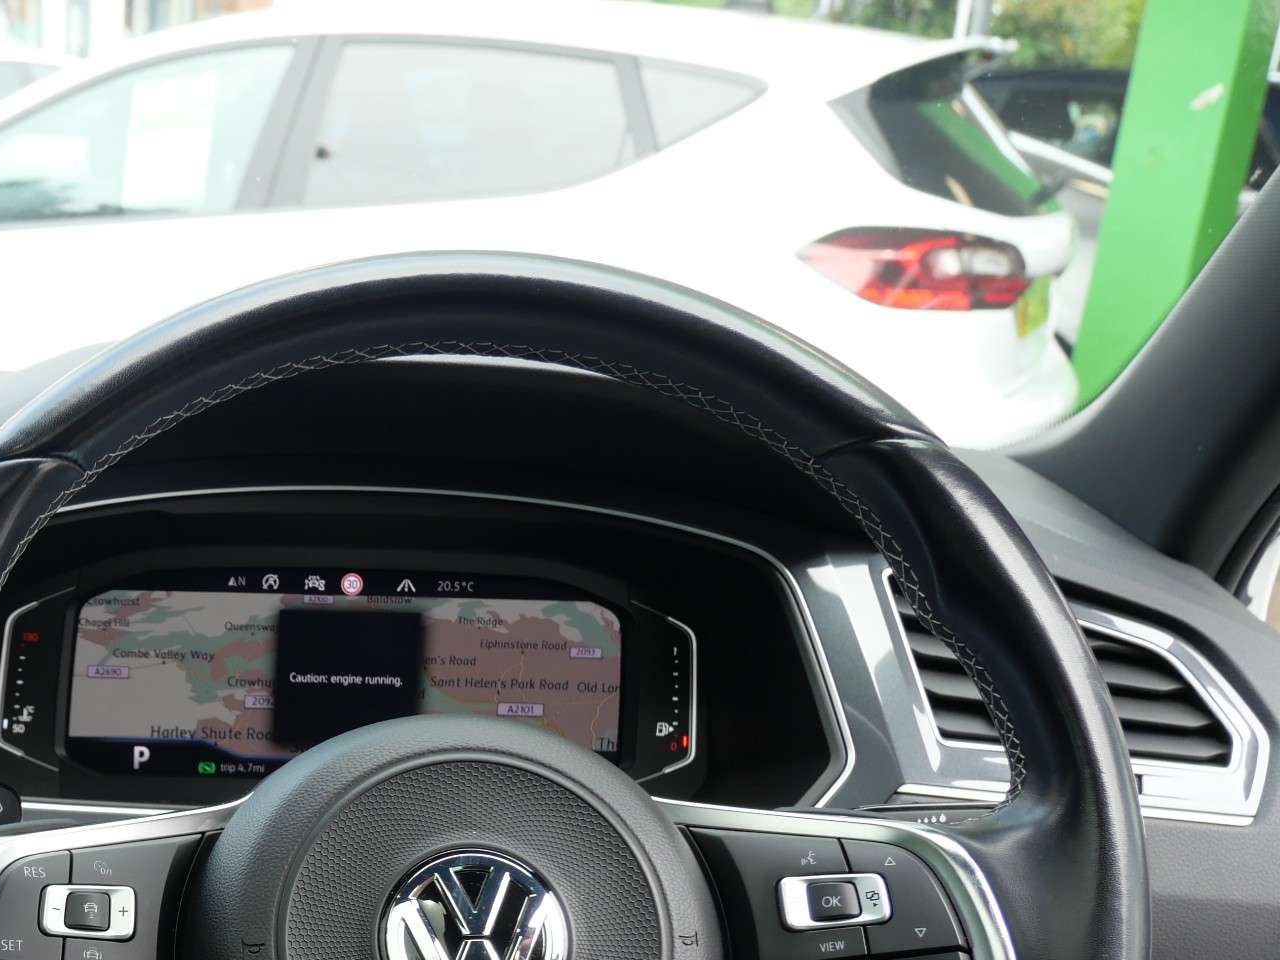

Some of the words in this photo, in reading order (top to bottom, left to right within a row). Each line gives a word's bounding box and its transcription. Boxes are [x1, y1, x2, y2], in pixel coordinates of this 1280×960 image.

[237, 576, 246, 586] N
[224, 621, 277, 632] Queenswa
[458, 616, 475, 625] The
[478, 616, 504, 626] Ridge
[480, 640, 538, 651] Elphinstone
[542, 641, 568, 650] Road
[112, 649, 150, 659] Combe
[155, 650, 185, 661] Valley
[191, 651, 215, 662] Way
[449, 656, 477, 666] Road
[227, 676, 272, 688] Crowhu
[289, 672, 328, 684] Caution:
[330, 674, 362, 686] engine
[365, 675, 403, 687] running.
[431, 676, 461, 688] Saint
[465, 677, 507, 689] Helen's
[510, 678, 535, 689] Park
[539, 679, 569, 691] Road
[577, 681, 598, 693] Old
[150, 726, 196, 740] Harley
[201, 726, 242, 740] Shute
[133, 745, 150, 769] P
[220, 762, 235, 774] trip
[23, 866, 47, 878] RES
[821, 895, 843, 908] OK
[1, 939, 23, 951] SET
[819, 940, 845, 952] VIEW
